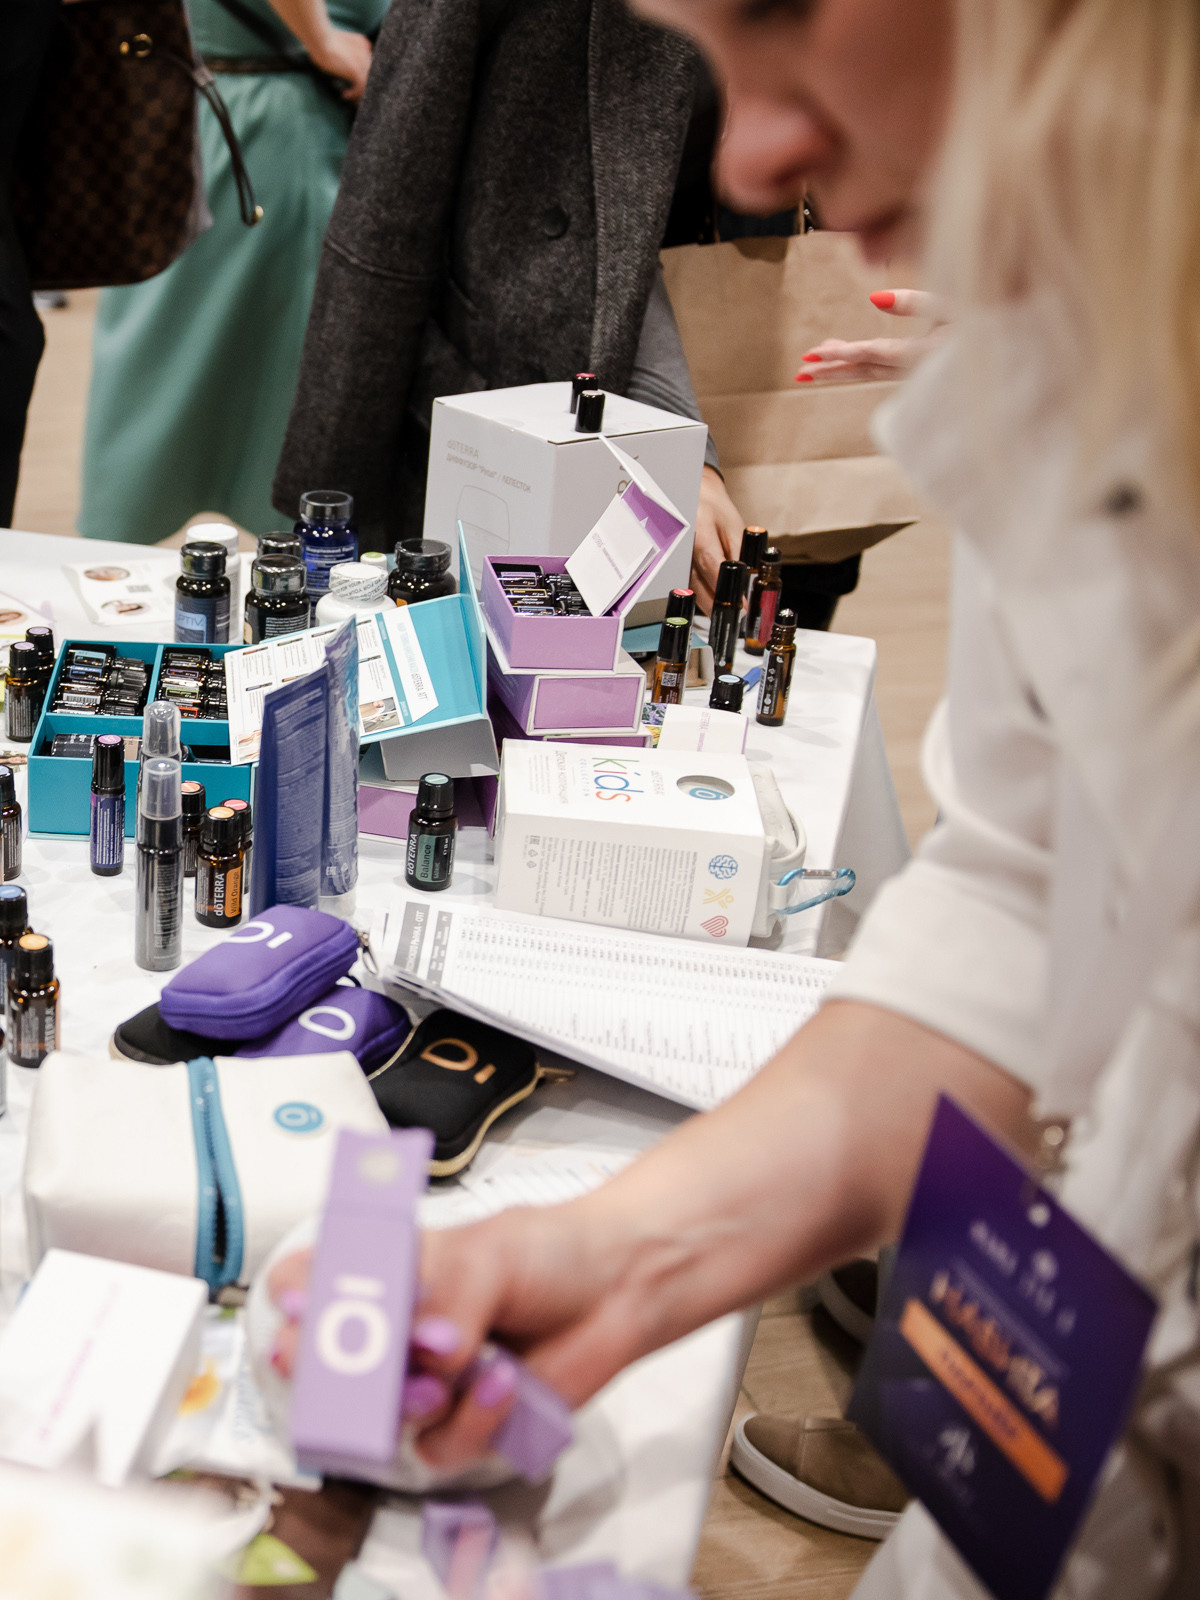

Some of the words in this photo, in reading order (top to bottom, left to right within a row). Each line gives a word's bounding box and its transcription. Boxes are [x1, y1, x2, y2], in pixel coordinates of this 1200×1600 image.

[591, 757, 644, 802] kids
[420, 844, 432, 878] Balance
[231, 871, 240, 897] Orange
[230, 898, 238, 915] Wild
